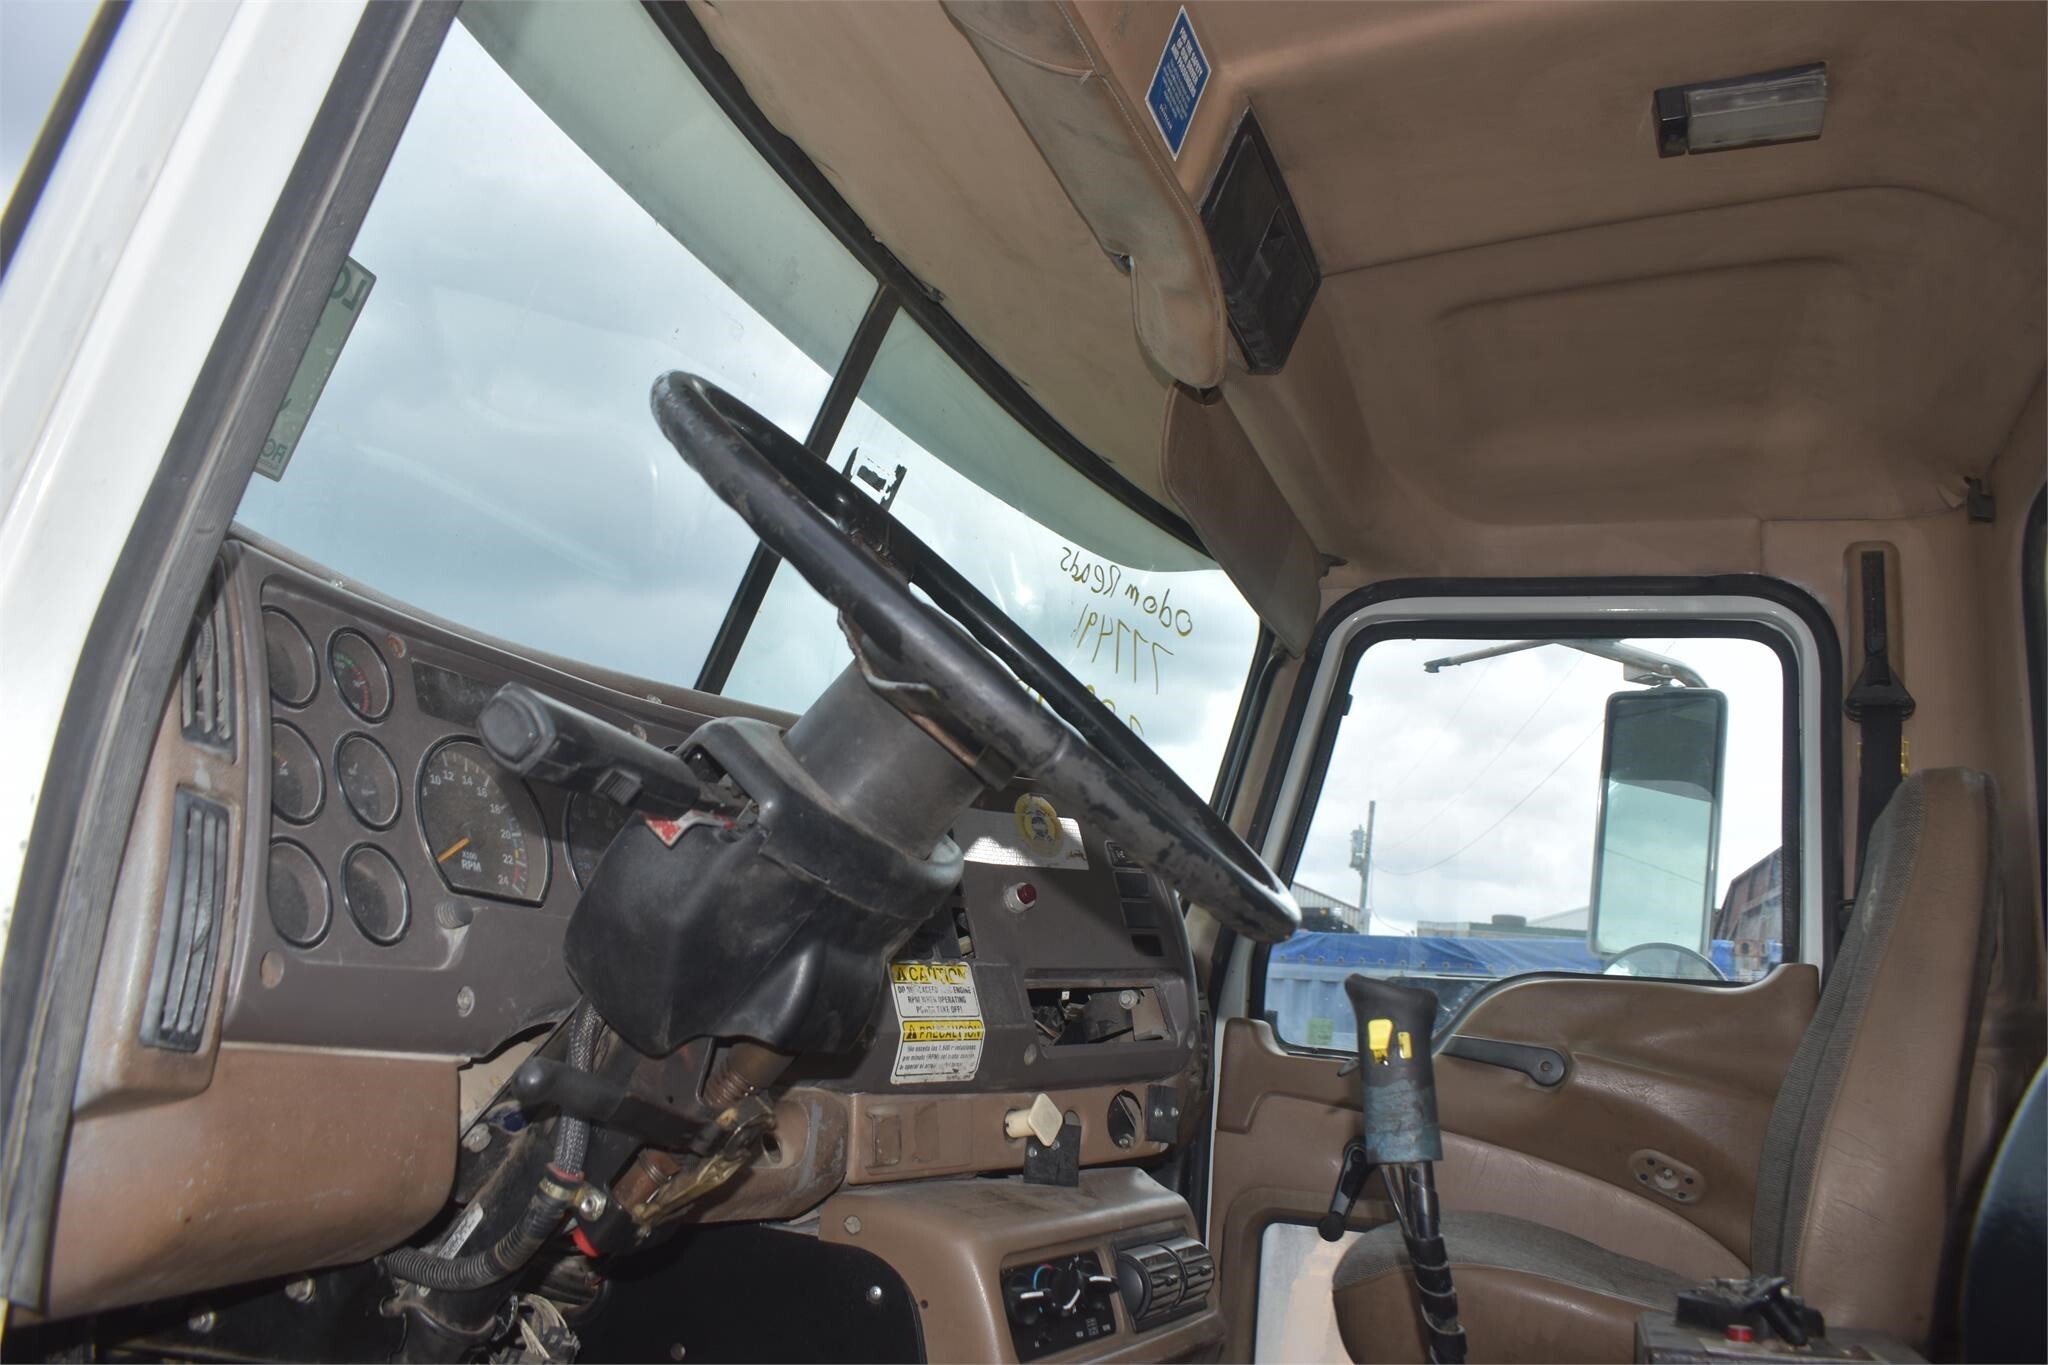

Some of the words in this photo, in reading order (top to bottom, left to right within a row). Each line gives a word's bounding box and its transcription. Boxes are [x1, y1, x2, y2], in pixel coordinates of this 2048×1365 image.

[430, 774, 441, 785] 10
[443, 770, 455, 781] 12
[462, 776, 473, 786] 14
[476, 787, 488, 798] 16
[501, 829, 511, 840] 20
[502, 854, 513, 865] 22
[461, 860, 481, 872] RPM
[498, 875, 509, 885] 24
[908, 966, 966, 984] CAUTION
